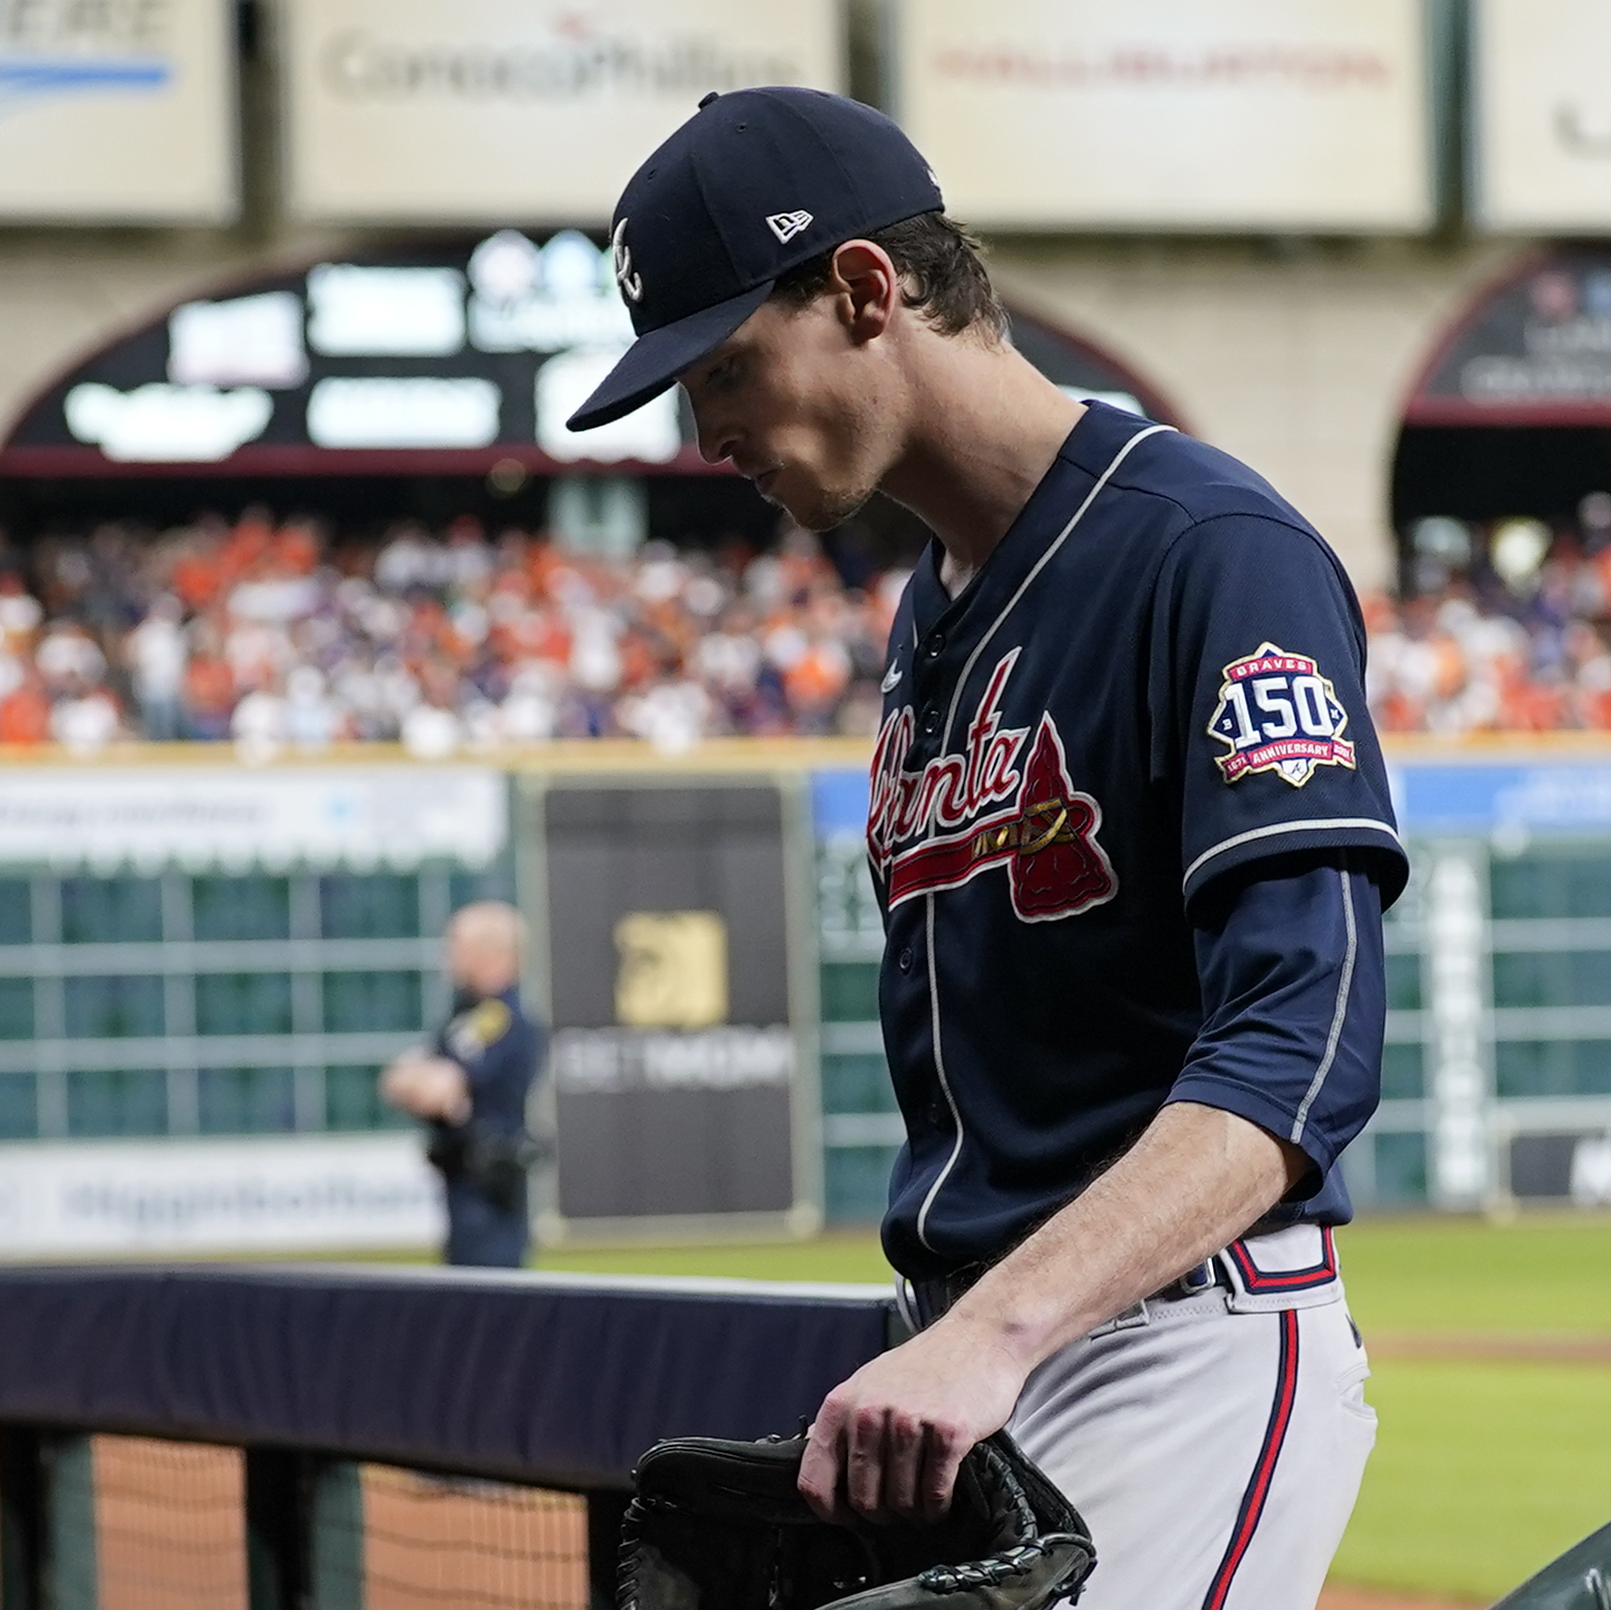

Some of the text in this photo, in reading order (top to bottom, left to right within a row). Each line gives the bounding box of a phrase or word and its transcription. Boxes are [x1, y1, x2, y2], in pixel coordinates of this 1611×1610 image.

[1236, 661, 1307, 677] BRAVES
[1224, 676, 1335, 750] 150
[1252, 743, 1329, 765] ANNIVERSARY
